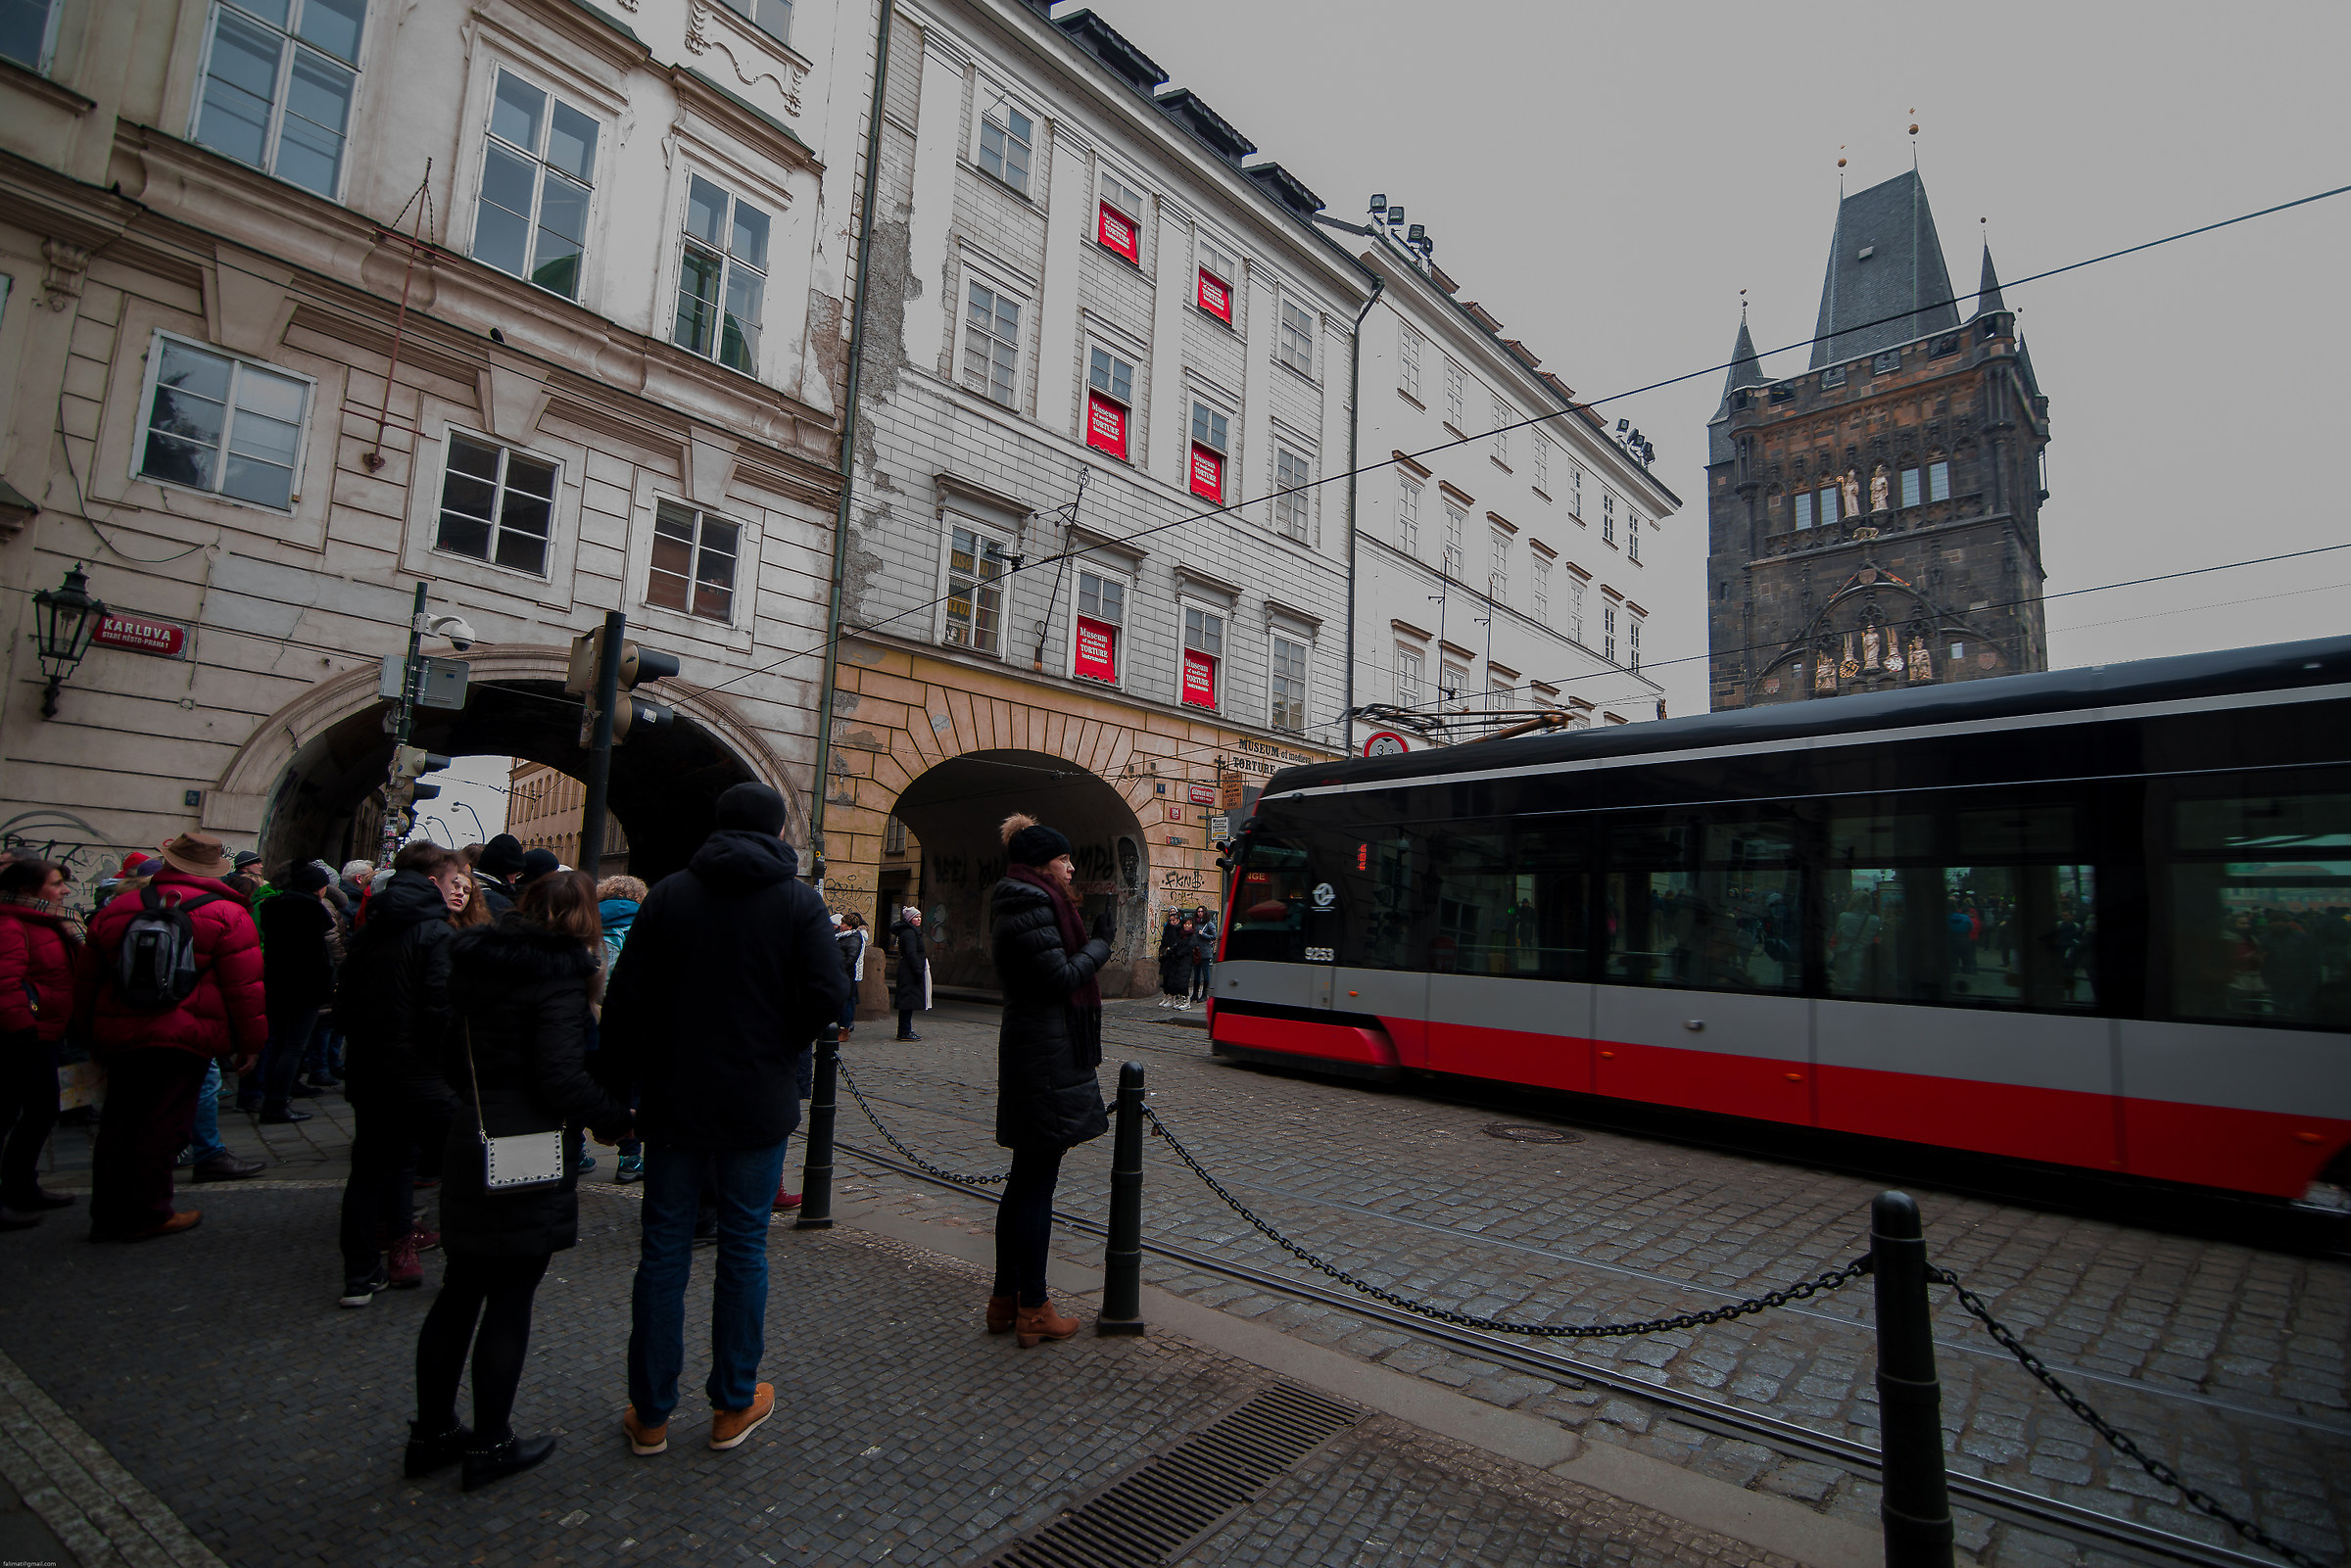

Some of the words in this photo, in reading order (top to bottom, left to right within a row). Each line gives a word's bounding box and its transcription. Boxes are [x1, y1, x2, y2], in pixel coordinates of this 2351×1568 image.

[1092, 401, 1119, 421] Museum
[1092, 416, 1120, 436] TORTURE
[104, 618, 171, 641] KARLOVA
[1080, 627, 1108, 643] Museum
[1080, 643, 1109, 658] TORTURE
[1185, 657, 1209, 673] Museum
[1185, 674, 1210, 687] TORTURE
[1238, 738, 1279, 758] MUSEUM
[1280, 750, 1288, 760] of
[1289, 752, 1315, 766] medieval
[1233, 757, 1276, 775] TORTURE
[1305, 946, 1335, 962] 9253
